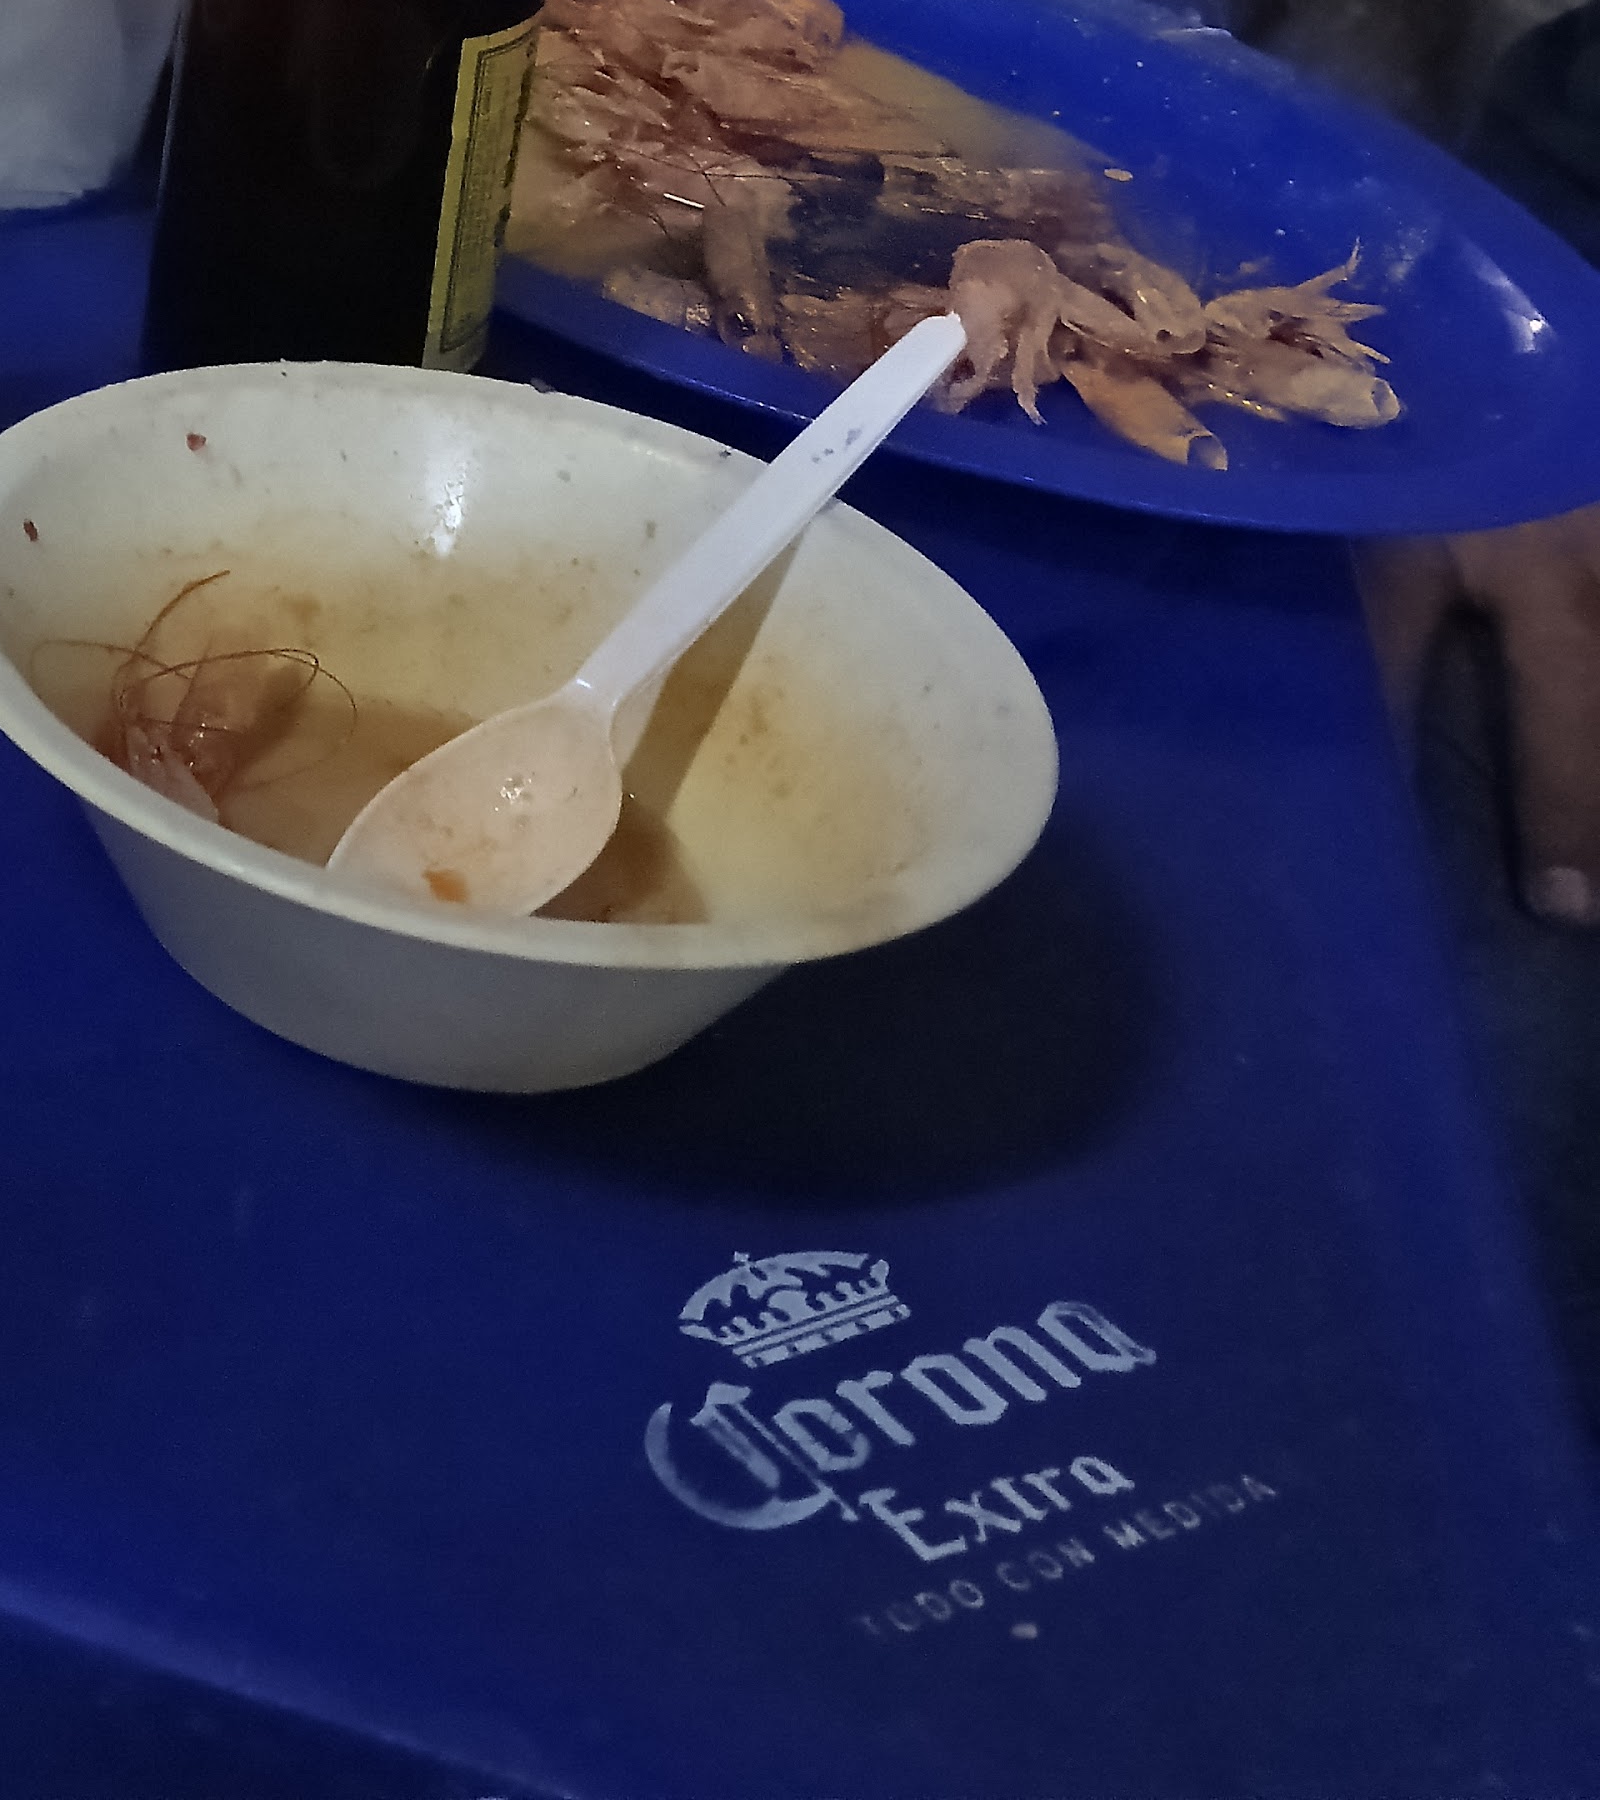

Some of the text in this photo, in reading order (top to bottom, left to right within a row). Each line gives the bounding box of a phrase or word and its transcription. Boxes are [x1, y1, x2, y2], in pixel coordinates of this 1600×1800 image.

[644, 1301, 1157, 1530] Corona
[858, 1455, 1135, 1561] Extra
[996, 1536, 1096, 1592] CON
